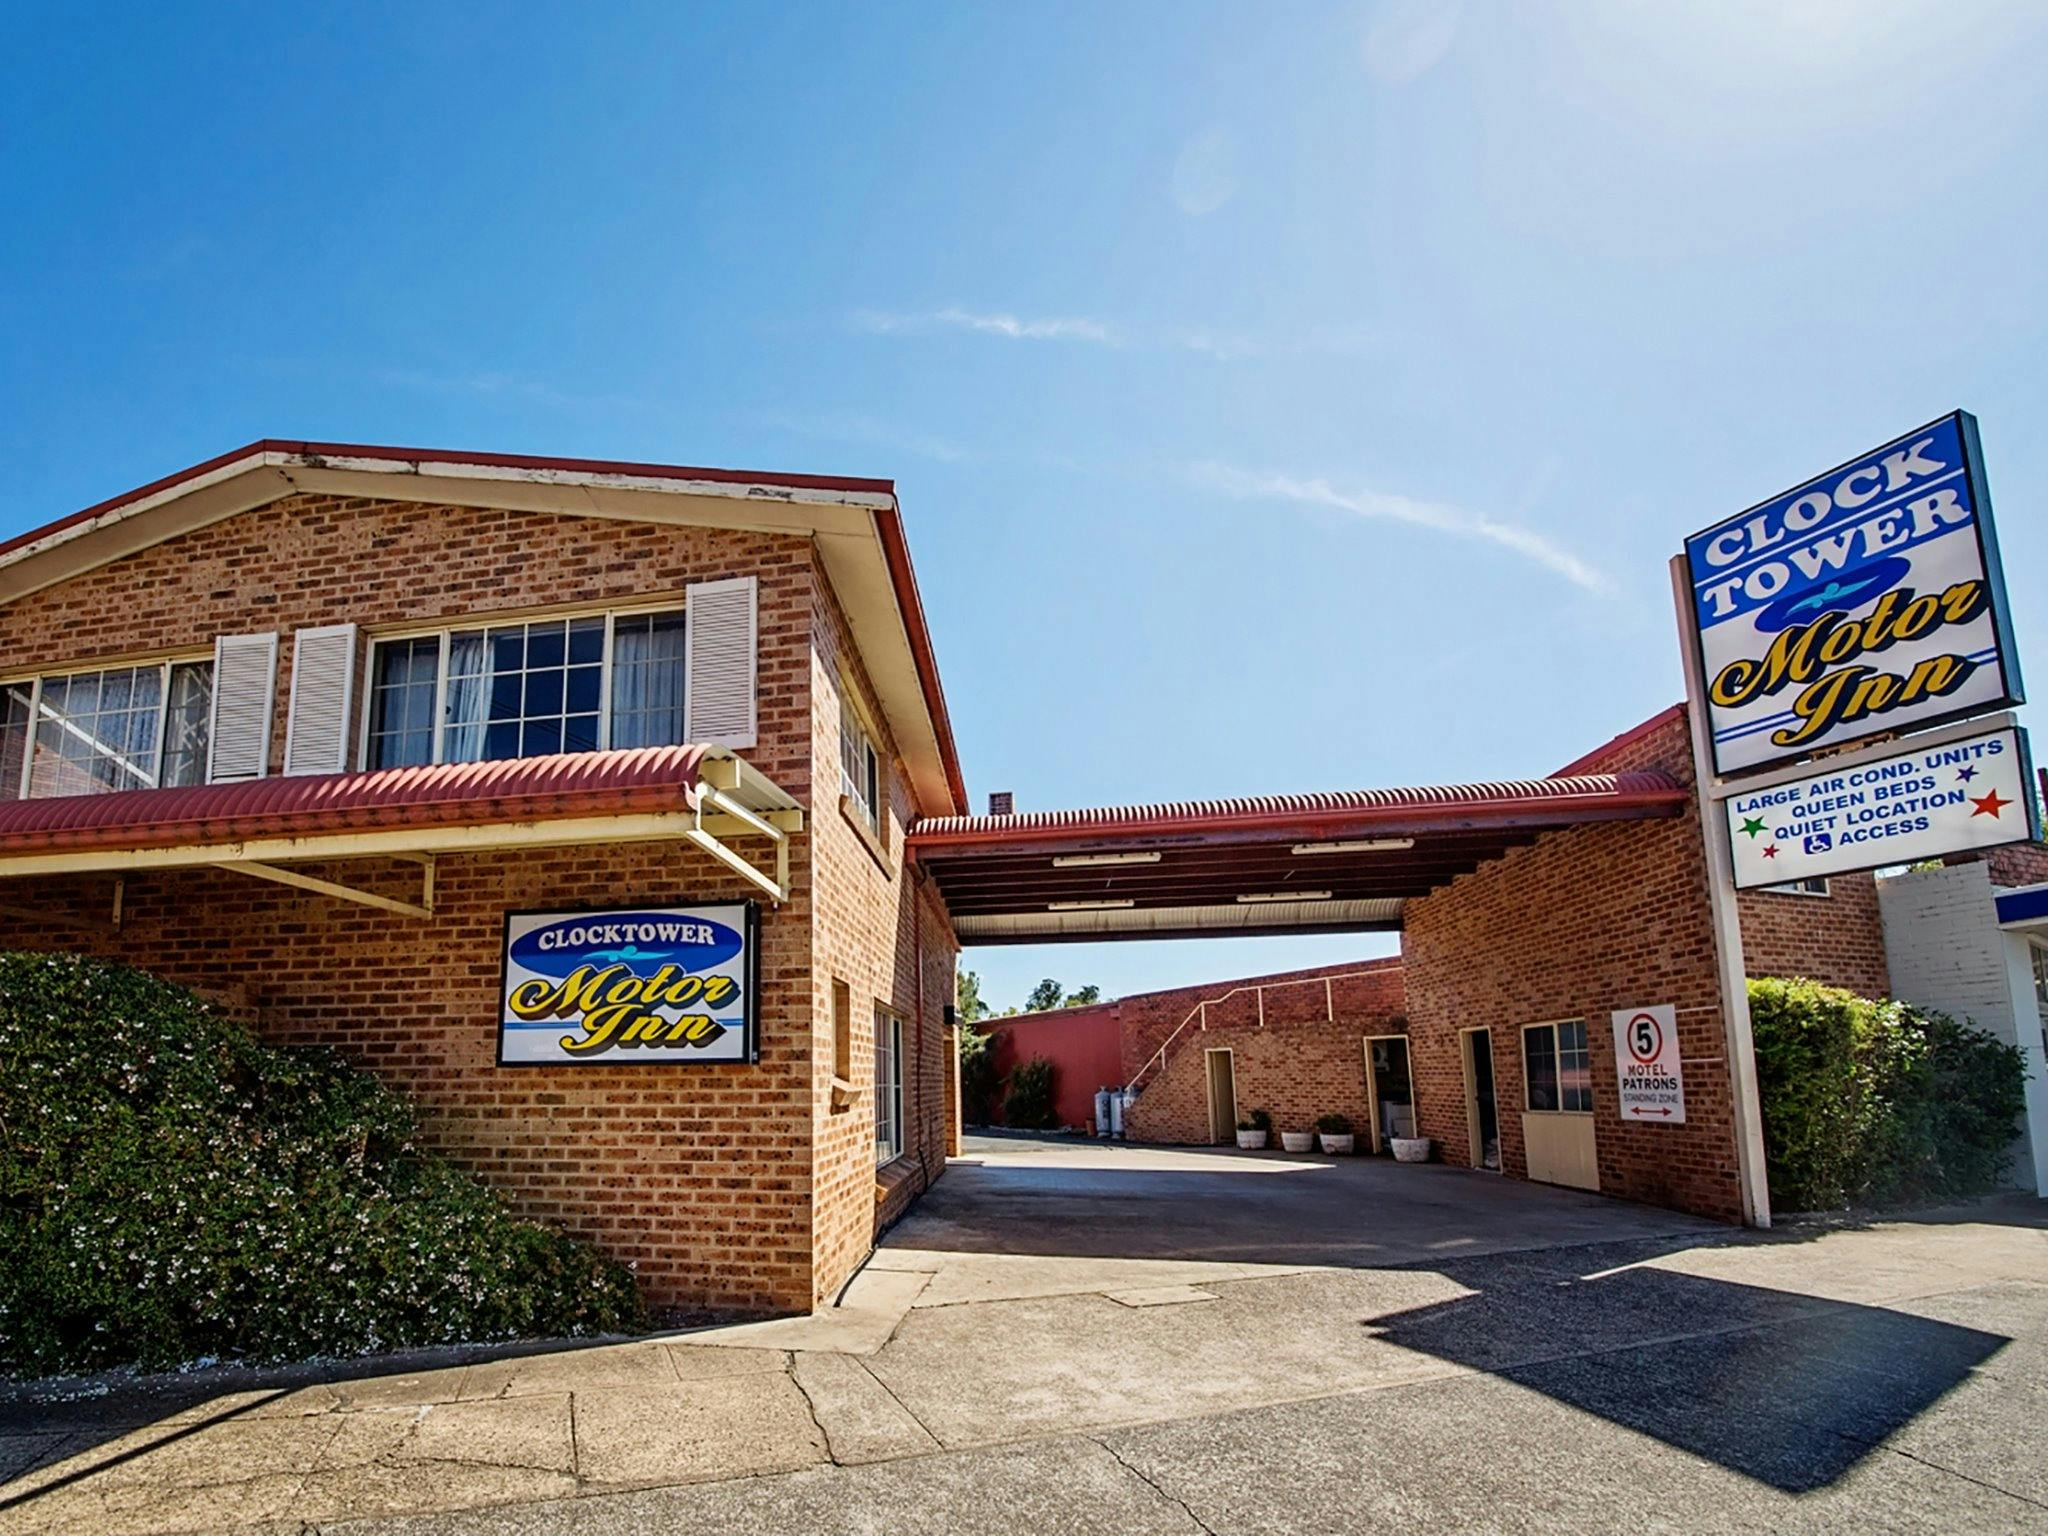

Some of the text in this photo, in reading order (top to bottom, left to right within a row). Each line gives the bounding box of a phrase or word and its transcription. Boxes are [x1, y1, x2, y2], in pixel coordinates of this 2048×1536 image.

[1705, 437, 1946, 566] CLOCK
[1703, 488, 1971, 618] TOWER
[1711, 580, 1987, 707] Motor
[1771, 655, 1975, 746] Inn
[1736, 739, 2004, 814] LARGE AIR COND. UNITS
[1792, 776, 1936, 818] QUEEN BEDS
[1775, 789, 1965, 840] QUIET LOCATION
[1838, 817, 1930, 846] ACCESS
[538, 923, 715, 950] CLOCKTOWER
[509, 964, 740, 1019] Motor
[560, 1004, 724, 1056] Inn
[1637, 1022, 1653, 1055] 5
[1622, 1077, 1678, 1090] PATRONS
